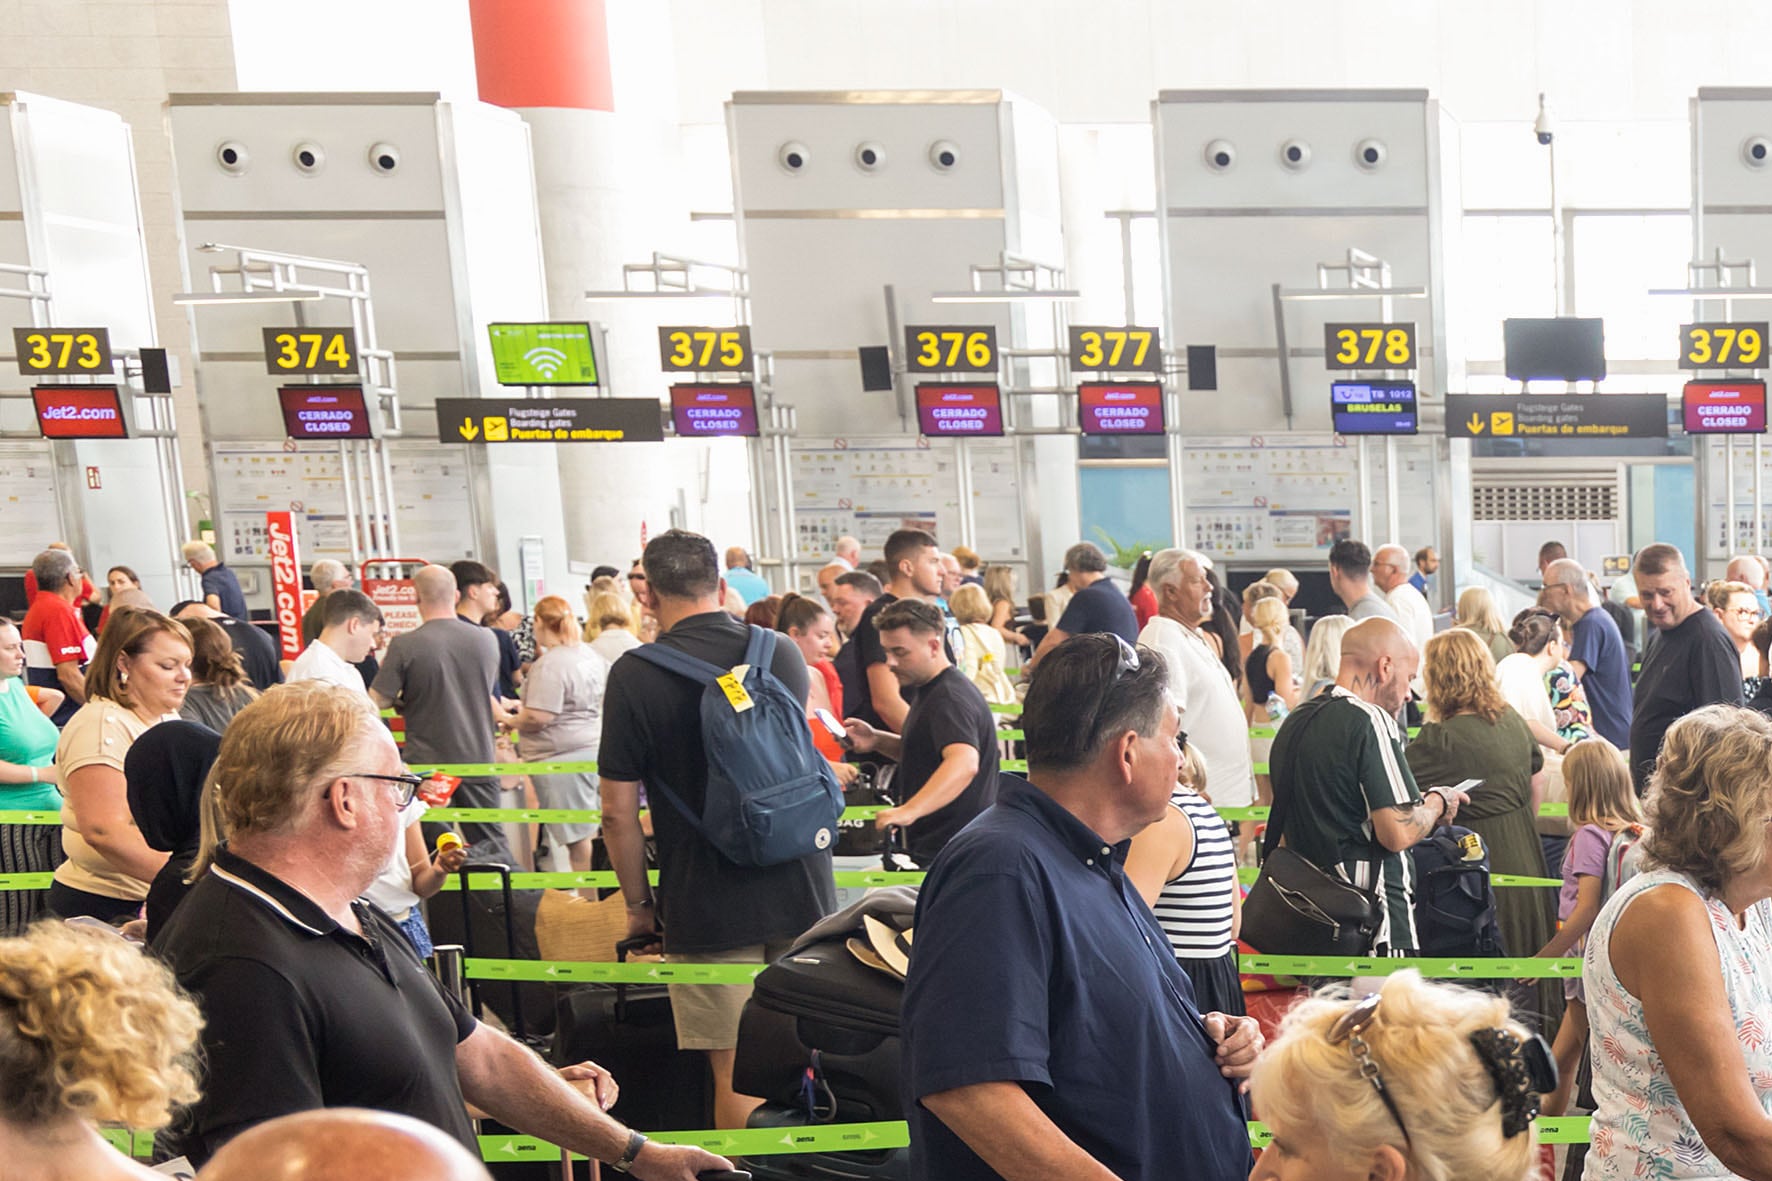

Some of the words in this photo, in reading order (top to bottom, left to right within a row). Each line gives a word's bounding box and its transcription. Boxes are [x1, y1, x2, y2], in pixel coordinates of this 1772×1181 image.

[26, 334, 101, 369] 373
[275, 334, 350, 368] 374
[669, 332, 744, 367] 375
[917, 332, 991, 367] 376
[1080, 332, 1151, 366] 377
[1336, 329, 1410, 364] 378
[1689, 329, 1761, 364] 379
[42, 406, 116, 420] Jet2.com
[552, 408, 576, 417] Gates
[932, 408, 987, 418] CERRADO
[1094, 407, 1149, 417] CERRADO
[1560, 403, 1584, 412] Gates
[1697, 405, 1751, 416] CERRADO
[298, 411, 353, 420] CERRADO
[687, 409, 742, 418] CERRADO
[305, 422, 351, 432] CLOSED
[693, 420, 738, 429] CLOSED
[938, 419, 983, 430] CLOSED
[1100, 418, 1145, 428] CLOSED
[1702, 417, 1747, 427] CLOSED
[511, 429, 552, 440] Puertas
[554, 429, 568, 439] de
[571, 429, 624, 441] embarque
[1518, 424, 1558, 434] Puertas
[1561, 424, 1574, 434] de
[1577, 424, 1628, 435] embarque
[269, 522, 299, 653] Jet2.com
[372, 585, 416, 595] Jet2.co
